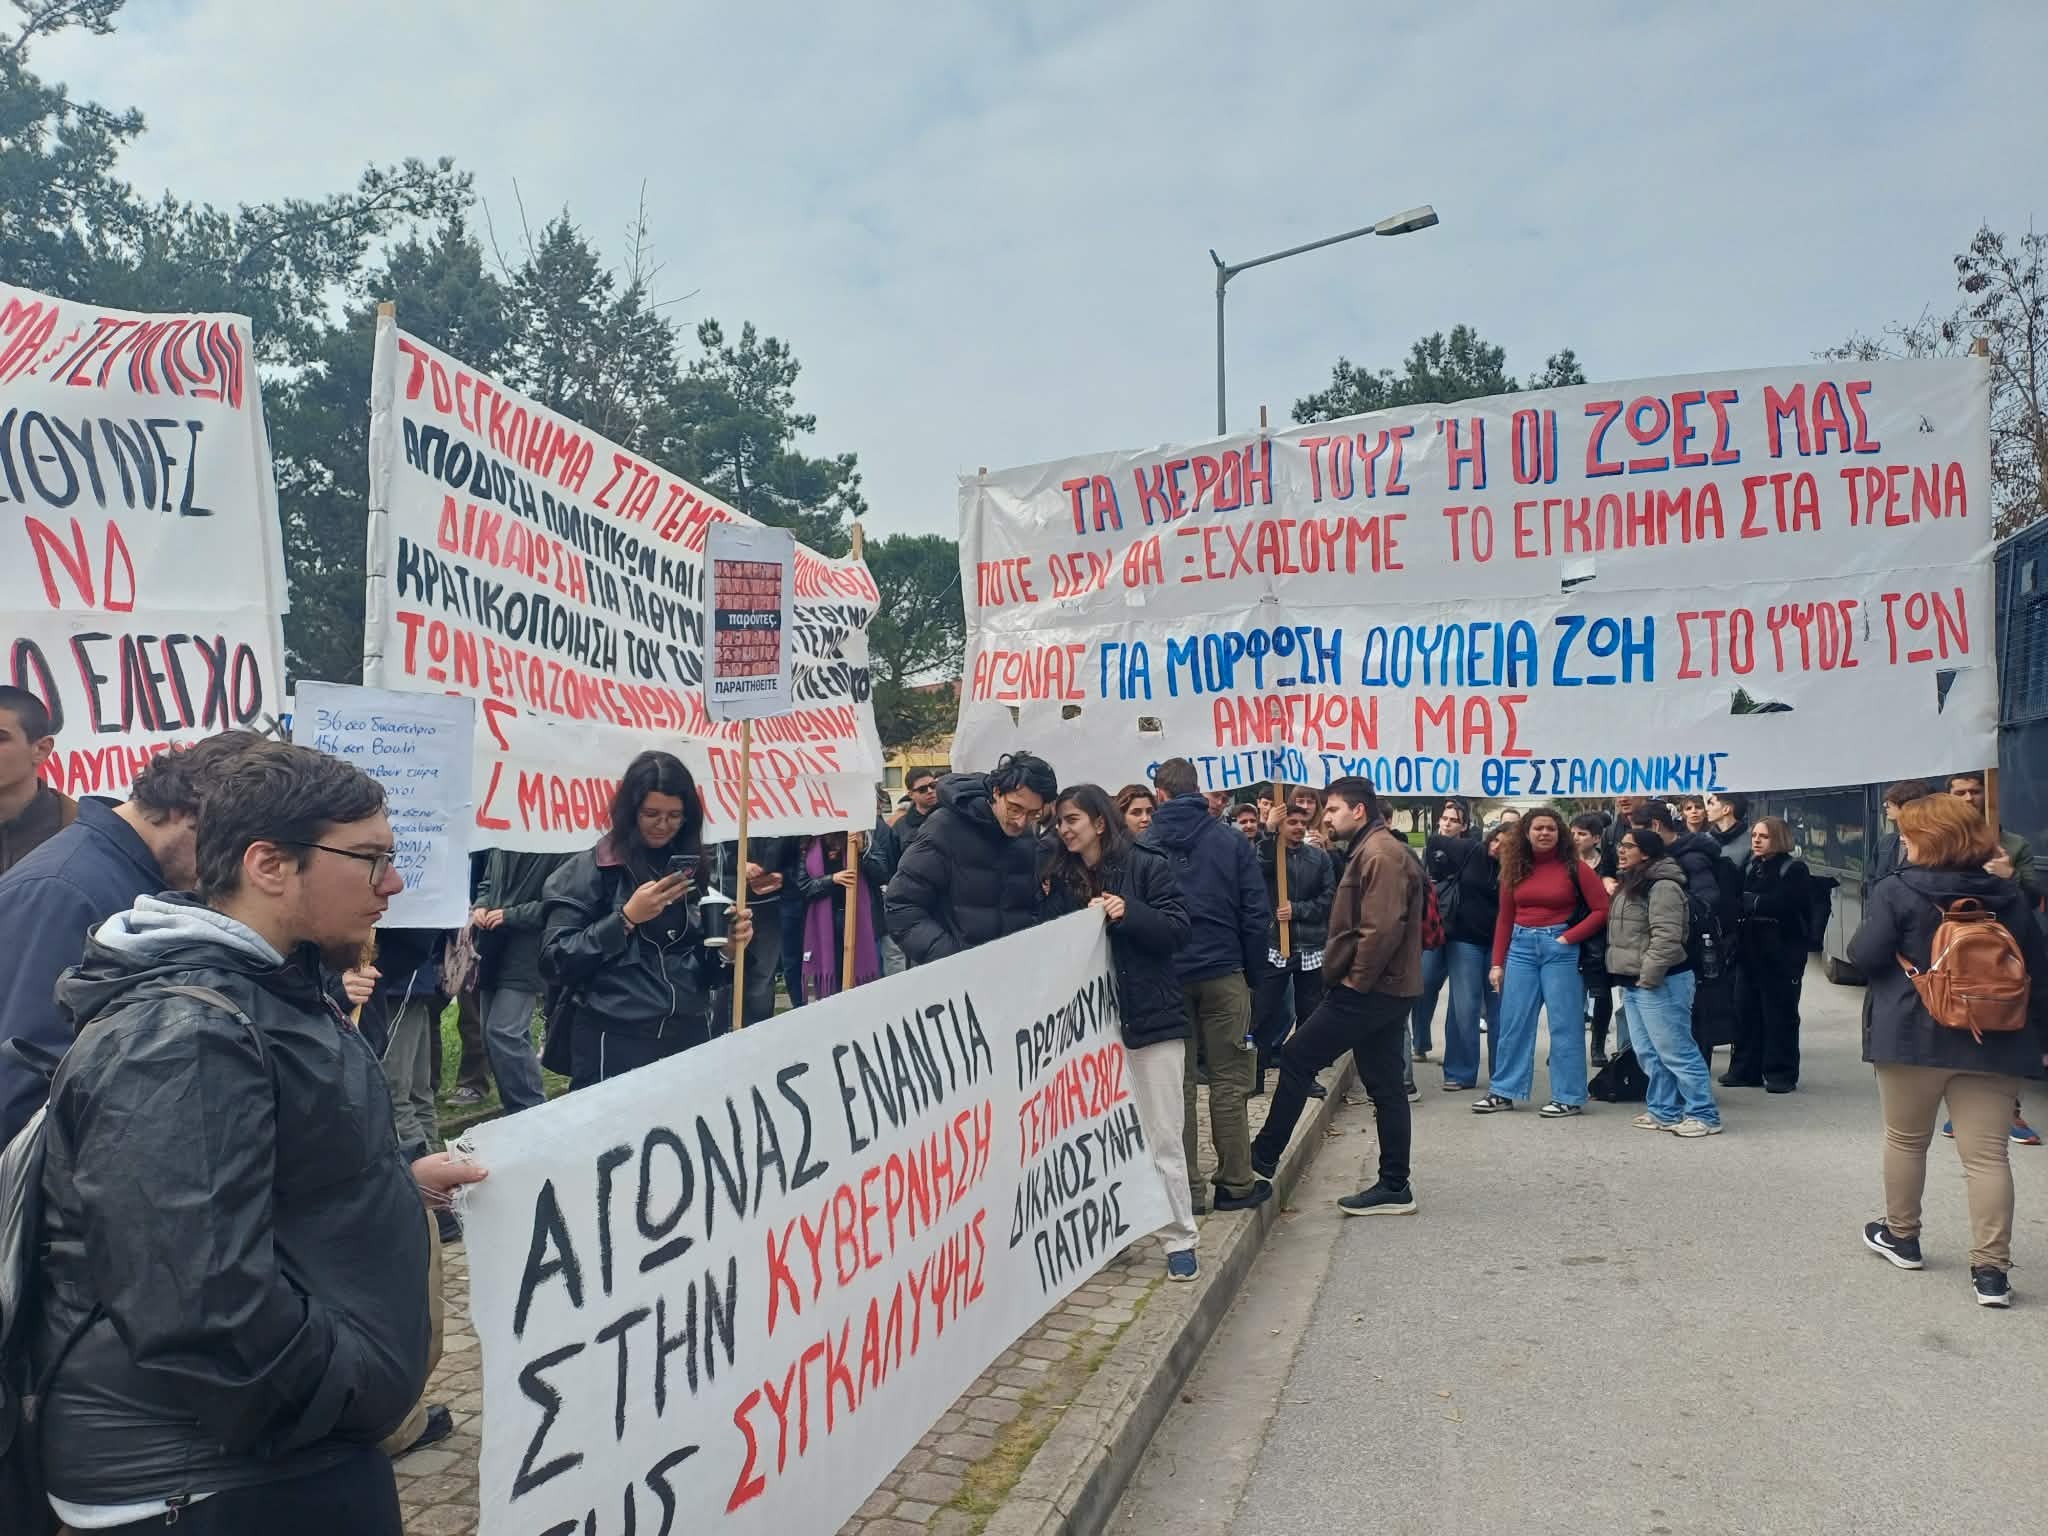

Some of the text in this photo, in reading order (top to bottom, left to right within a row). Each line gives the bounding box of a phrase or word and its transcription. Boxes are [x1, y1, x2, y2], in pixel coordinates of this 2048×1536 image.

[0, 407, 214, 517] ΥΘΥΝΕΣ
[398, 338, 453, 414] ΤΟ
[455, 371, 594, 494] ΕΓΚΛΗΜΑ
[593, 453, 660, 523] ΣΤΑ
[1062, 476, 1123, 535] ΤΑ
[1134, 441, 1272, 525] ΚΕΡΔΗ
[1300, 427, 1414, 503] ΤΟΥΣ
[1511, 409, 1557, 484] ΟΙ
[1584, 390, 1740, 478] ΖΩΕΣ
[1764, 381, 1881, 458] ΜΑΣ
[402, 416, 539, 523] ΑΠΟΔΟΣΗ
[541, 490, 656, 583] ΠΟΛΙΤΙΚΩΝ
[661, 556, 694, 600] ΚΑΙ
[437, 495, 586, 604] ΔΙΚΑΙΩΣΗ
[585, 557, 621, 616] ΓΙΑ
[620, 575, 649, 628] ΤΑ
[976, 462, 1968, 607] ΠΟΤΕ ΔΕΝ ΘΑ ΞΕΧΑΣΟΥΜΕ ΤΟ ΕΓΚΛΗΜΑ ΣΤΑ ΤΡΕΝΑ
[397, 536, 617, 675] ΚΡΑΤΙΚΟΠΟΙΗΣΗ
[624, 629, 667, 682] ΤΟΥ
[397, 611, 479, 688] ΤΩΝ
[483, 637, 687, 729] ΕΡΓΑΖΟΜΕΝΩΝ
[971, 643, 1087, 701] ΑΓΩΝΑΣ
[1100, 640, 1152, 700] ΓΙΑ
[1167, 625, 1343, 697] ΜΟΡΦΩΣΗ
[1362, 619, 1538, 688] ΔΟΥΛΕΙΑ
[1553, 615, 1655, 686] ΖΩΗ
[1677, 608, 1755, 680] ΣΤΟ
[1880, 587, 1970, 665] ΤΩΝ
[69, 631, 262, 734] ΕΛΕΓΧΟ
[317, 709, 342, 731] 36
[715, 679, 779, 694] ΠΑΡΑΙΤΗΘΕΙΤΕ
[1213, 693, 1533, 757] ΑΝΑΓΚΩΝ ΜΑΣ
[1481, 752, 1728, 796] ΘΕΣΣΑΛΟΝΙΚΗΣ
[513, 991, 992, 1342] ΑΓΩΝΑΣ ΕΝΑΝΤΙΑ
[1019, 1058, 1088, 1168] ΤΕΜΠΗ
[1010, 1102, 1145, 1250] ΔΙΚΑΙΟΣΥΝΗ
[1034, 1181, 1130, 1295] ΠΑΤΡΑΣ
[510, 1098, 991, 1504] ΣΤΗΝ ΚΥΒΕΡΝΗΣΗ
[726, 1208, 985, 1514] ΣΥΓΚΑΛΥΨΗΣ
